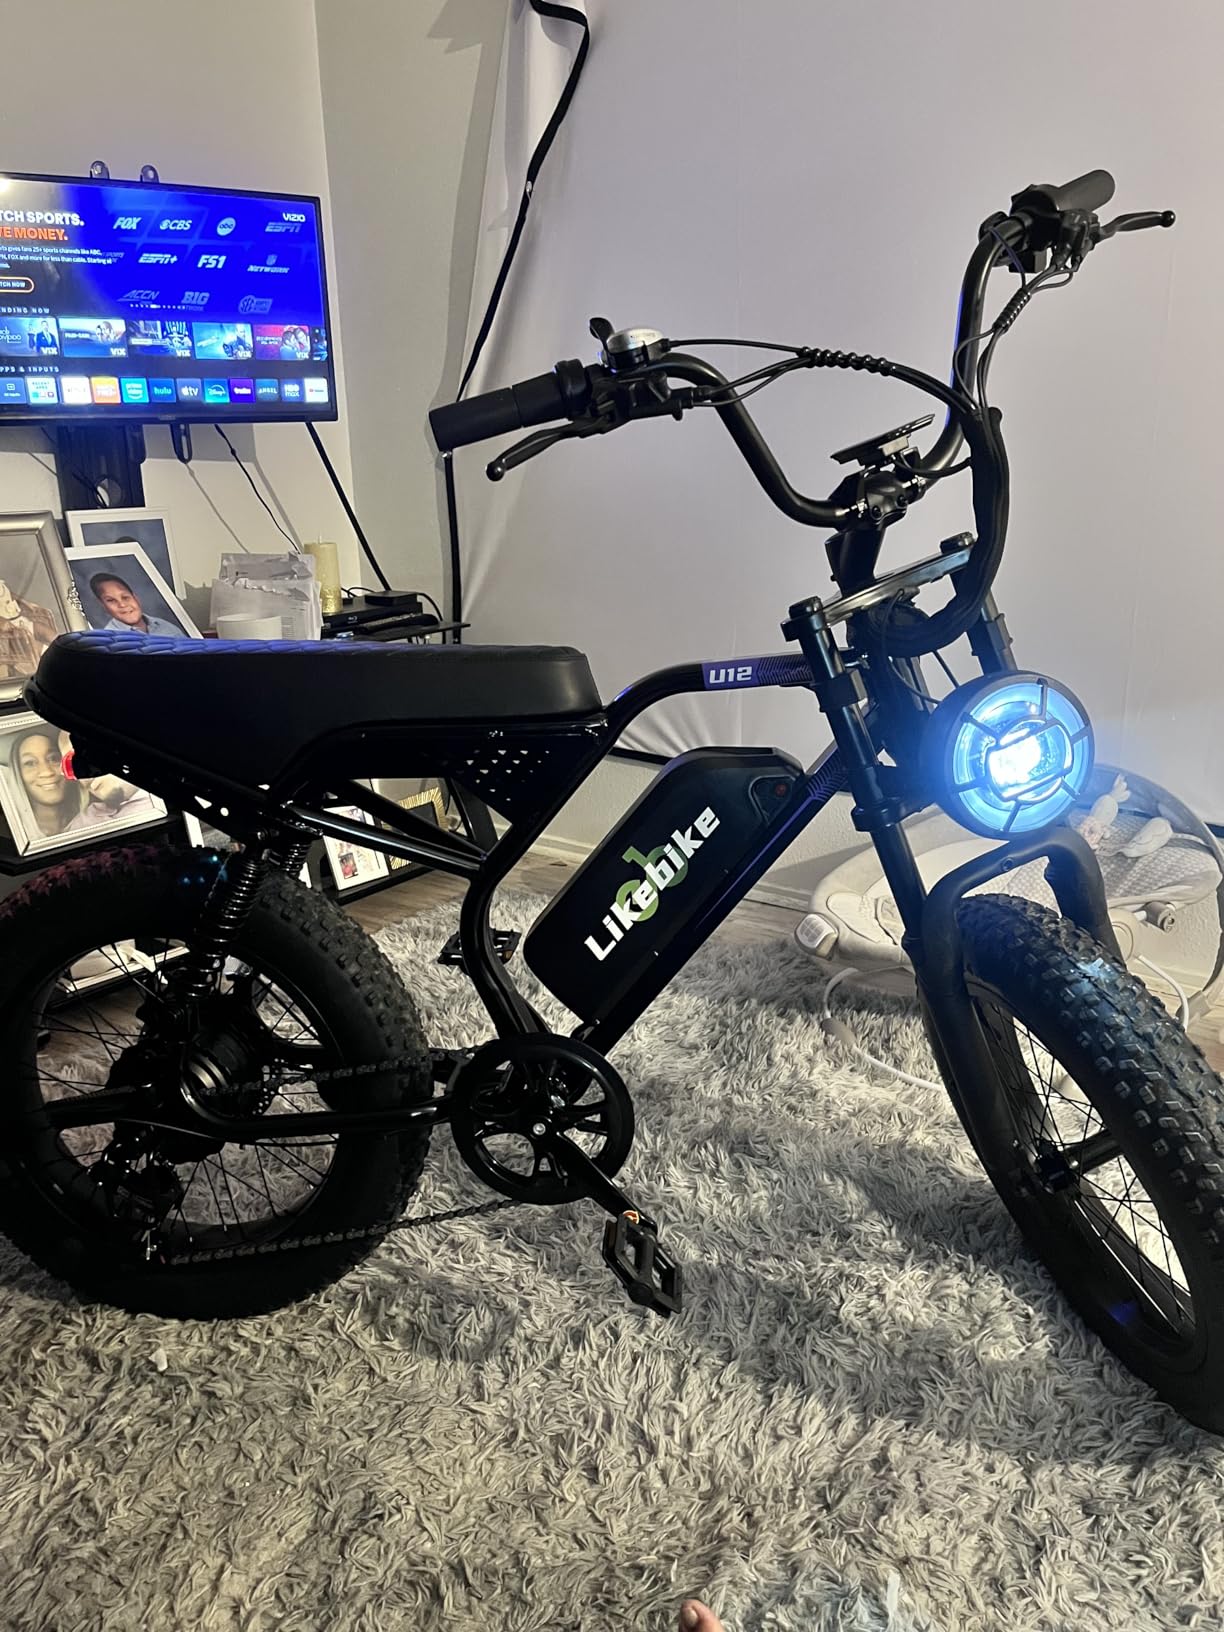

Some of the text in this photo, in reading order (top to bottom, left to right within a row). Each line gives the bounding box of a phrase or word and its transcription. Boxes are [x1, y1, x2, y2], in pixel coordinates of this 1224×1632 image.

[26, 211, 85, 227] SPORTS.
[113, 217, 142, 230] FOX
[282, 212, 306, 223] VIZIO
[168, 219, 193, 231] CBS
[264, 222, 302, 233] ESPN
[14, 227, 69, 241] MONEY.
[197, 254, 227, 269] FS1
[181, 291, 210, 305] BIG
[153, 386, 172, 395] hulu
[709, 666, 753, 684] U12
[584, 806, 721, 962] Likebike
